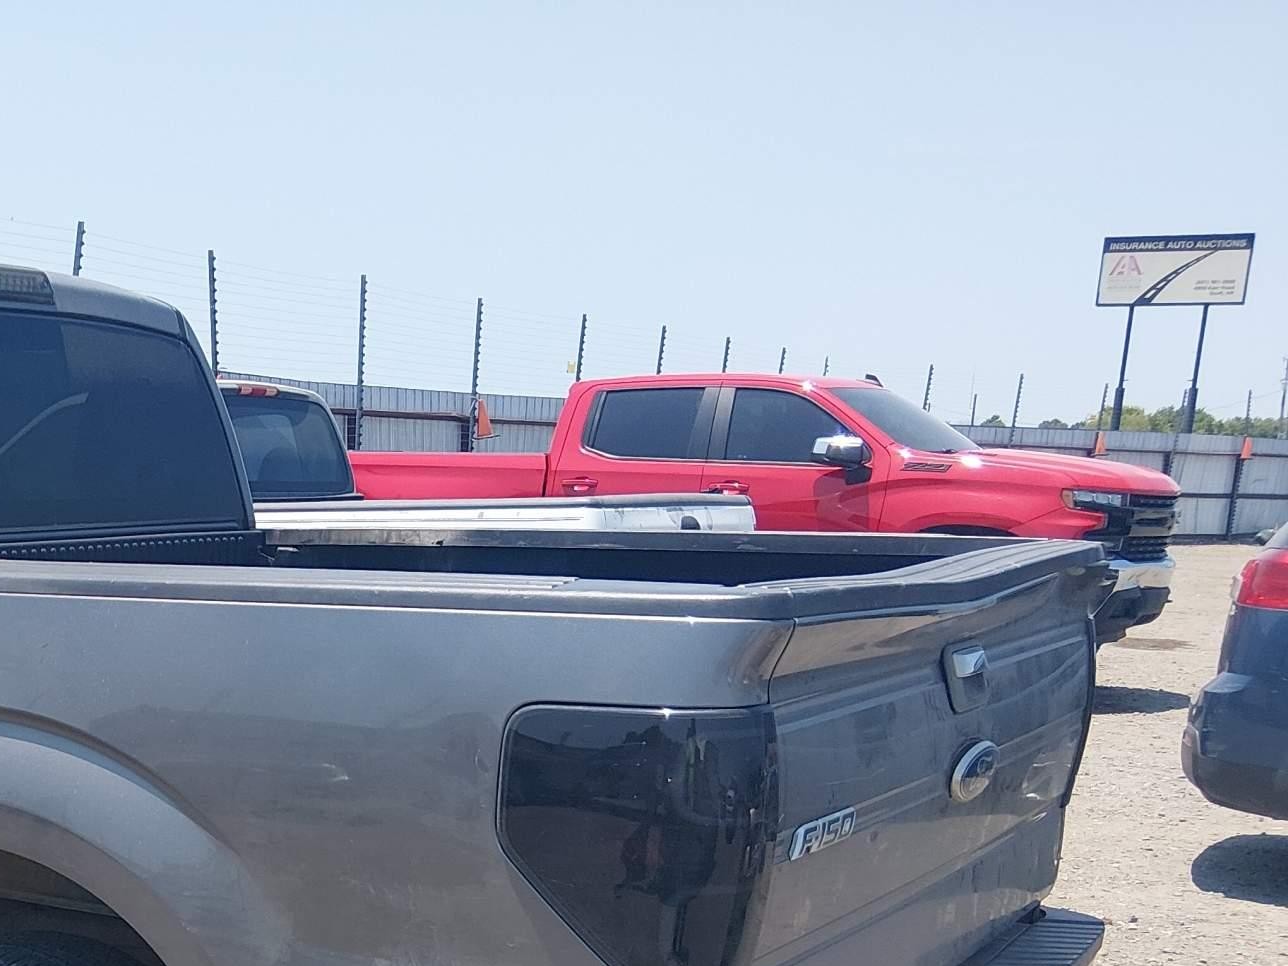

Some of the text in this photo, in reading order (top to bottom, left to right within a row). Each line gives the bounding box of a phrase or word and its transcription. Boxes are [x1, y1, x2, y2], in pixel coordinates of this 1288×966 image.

[1110, 239, 1247, 250] INSURANCE AUTO AUCTIONS
